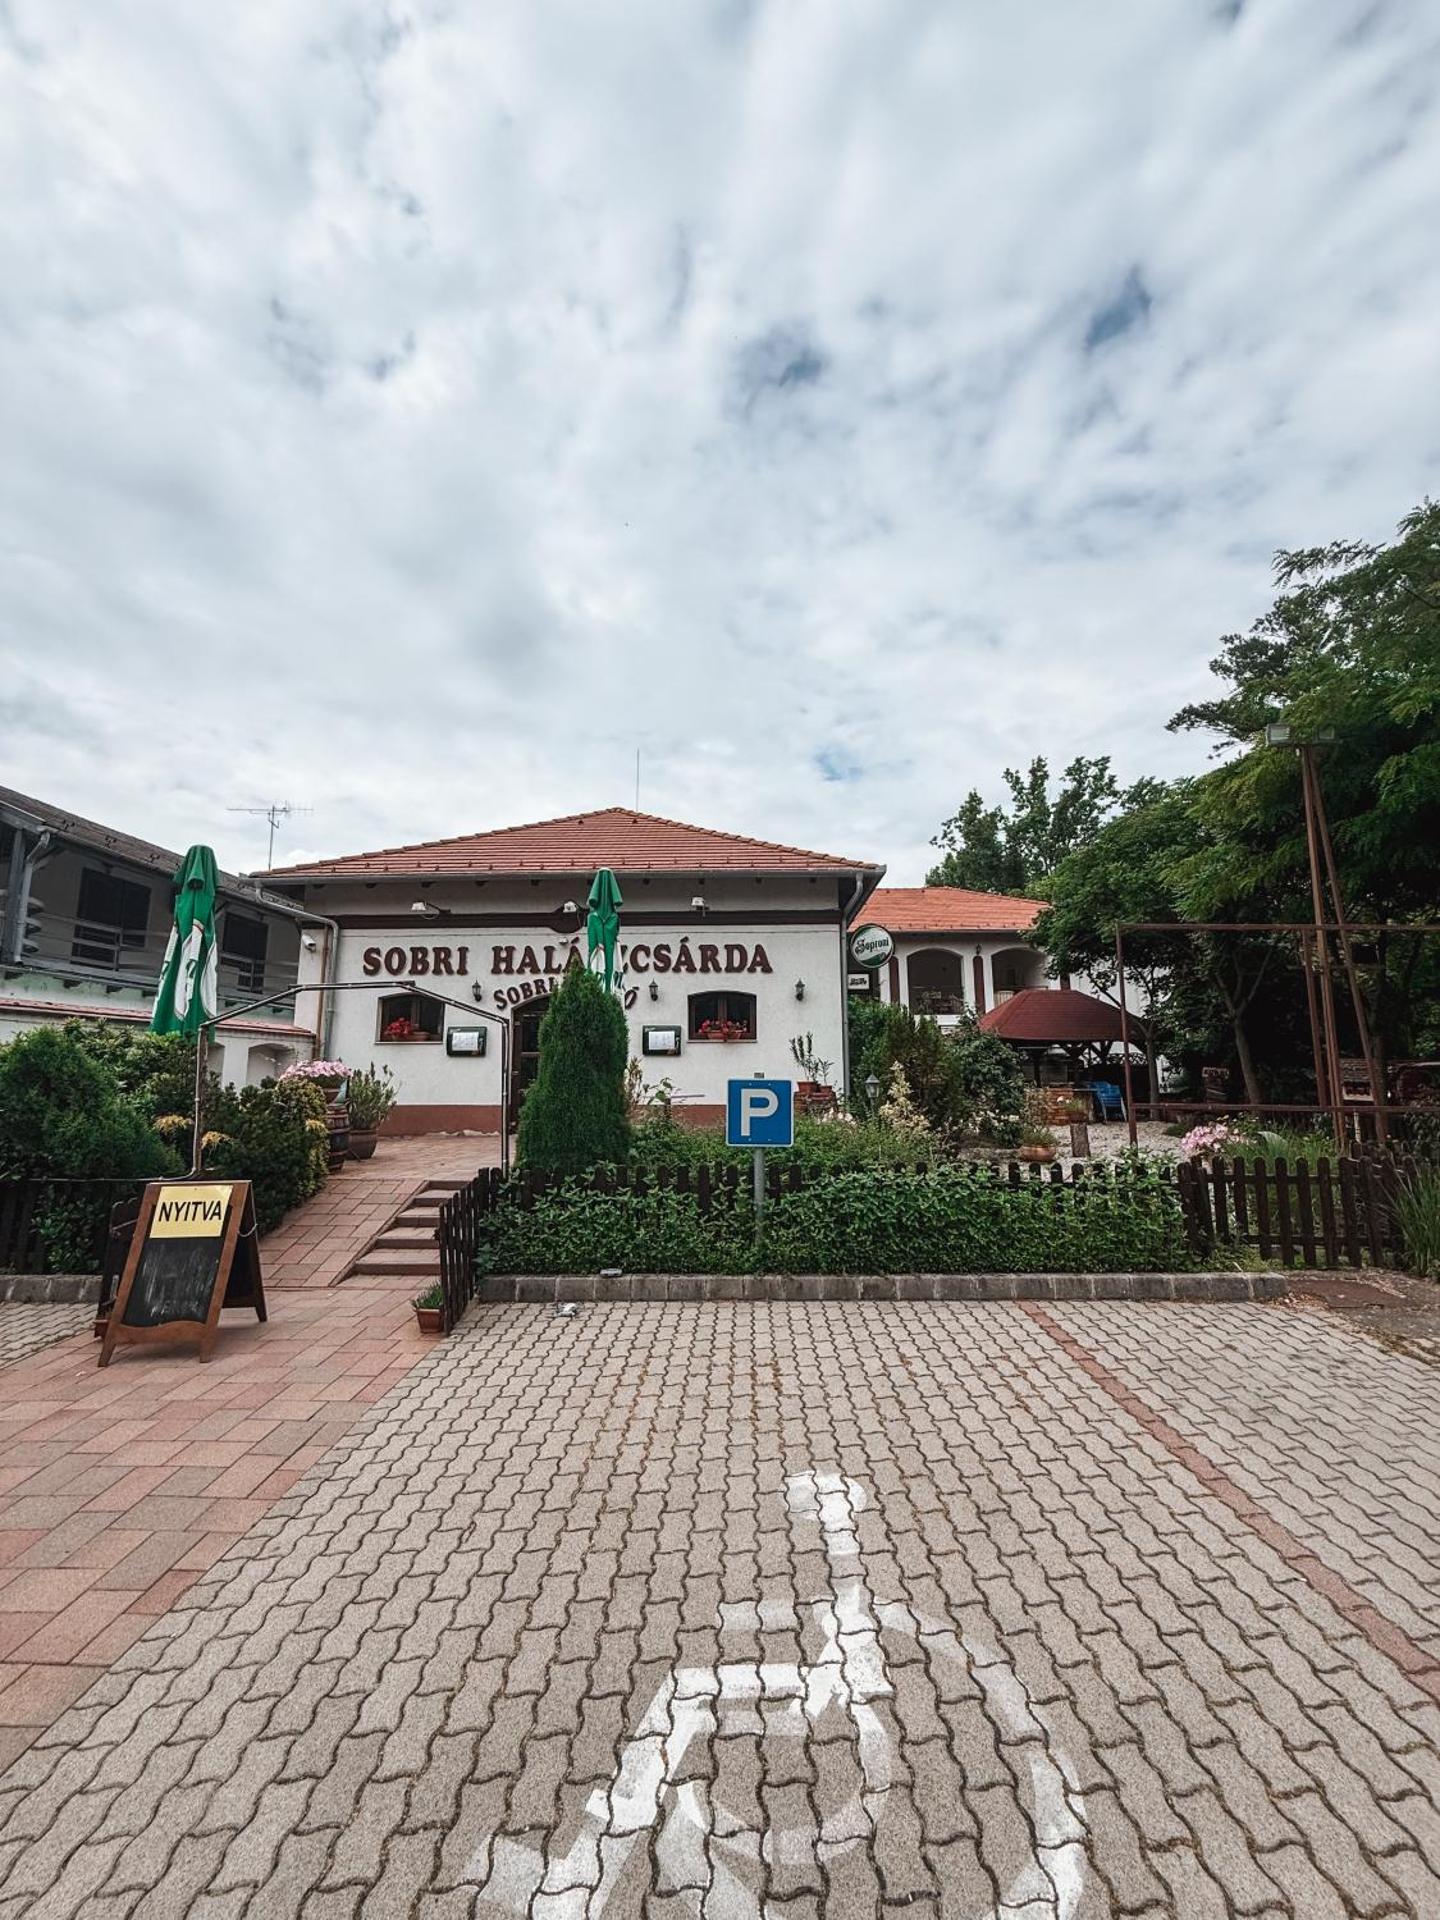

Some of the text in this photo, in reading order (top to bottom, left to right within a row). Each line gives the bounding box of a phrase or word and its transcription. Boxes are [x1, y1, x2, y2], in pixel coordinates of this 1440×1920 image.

[363, 936, 773, 976] SOBRI HALÁCSÁRDA
[740, 1088, 779, 1137] P
[157, 1200, 223, 1223] NYITVA
